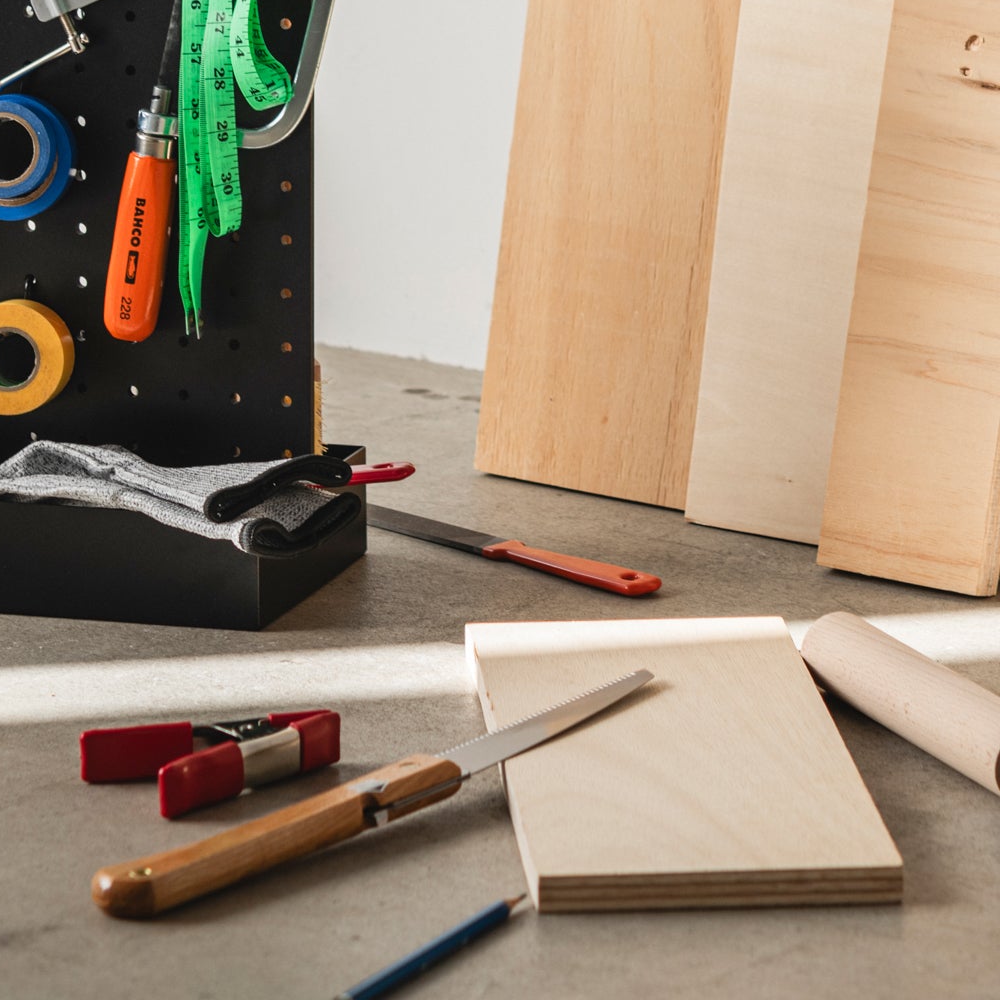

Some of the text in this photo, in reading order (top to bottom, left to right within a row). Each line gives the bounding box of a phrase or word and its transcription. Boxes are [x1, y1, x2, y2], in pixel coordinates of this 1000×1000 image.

[215, 12, 226, 34] 27
[191, 43, 202, 65] 57
[214, 68, 225, 91] 28
[235, 36, 245, 57] 44
[249, 87, 267, 103] 45
[217, 121, 228, 142] 29
[221, 172, 233, 195] 30
[130, 198, 146, 247] BAHCO
[120, 296, 132, 320] 228
